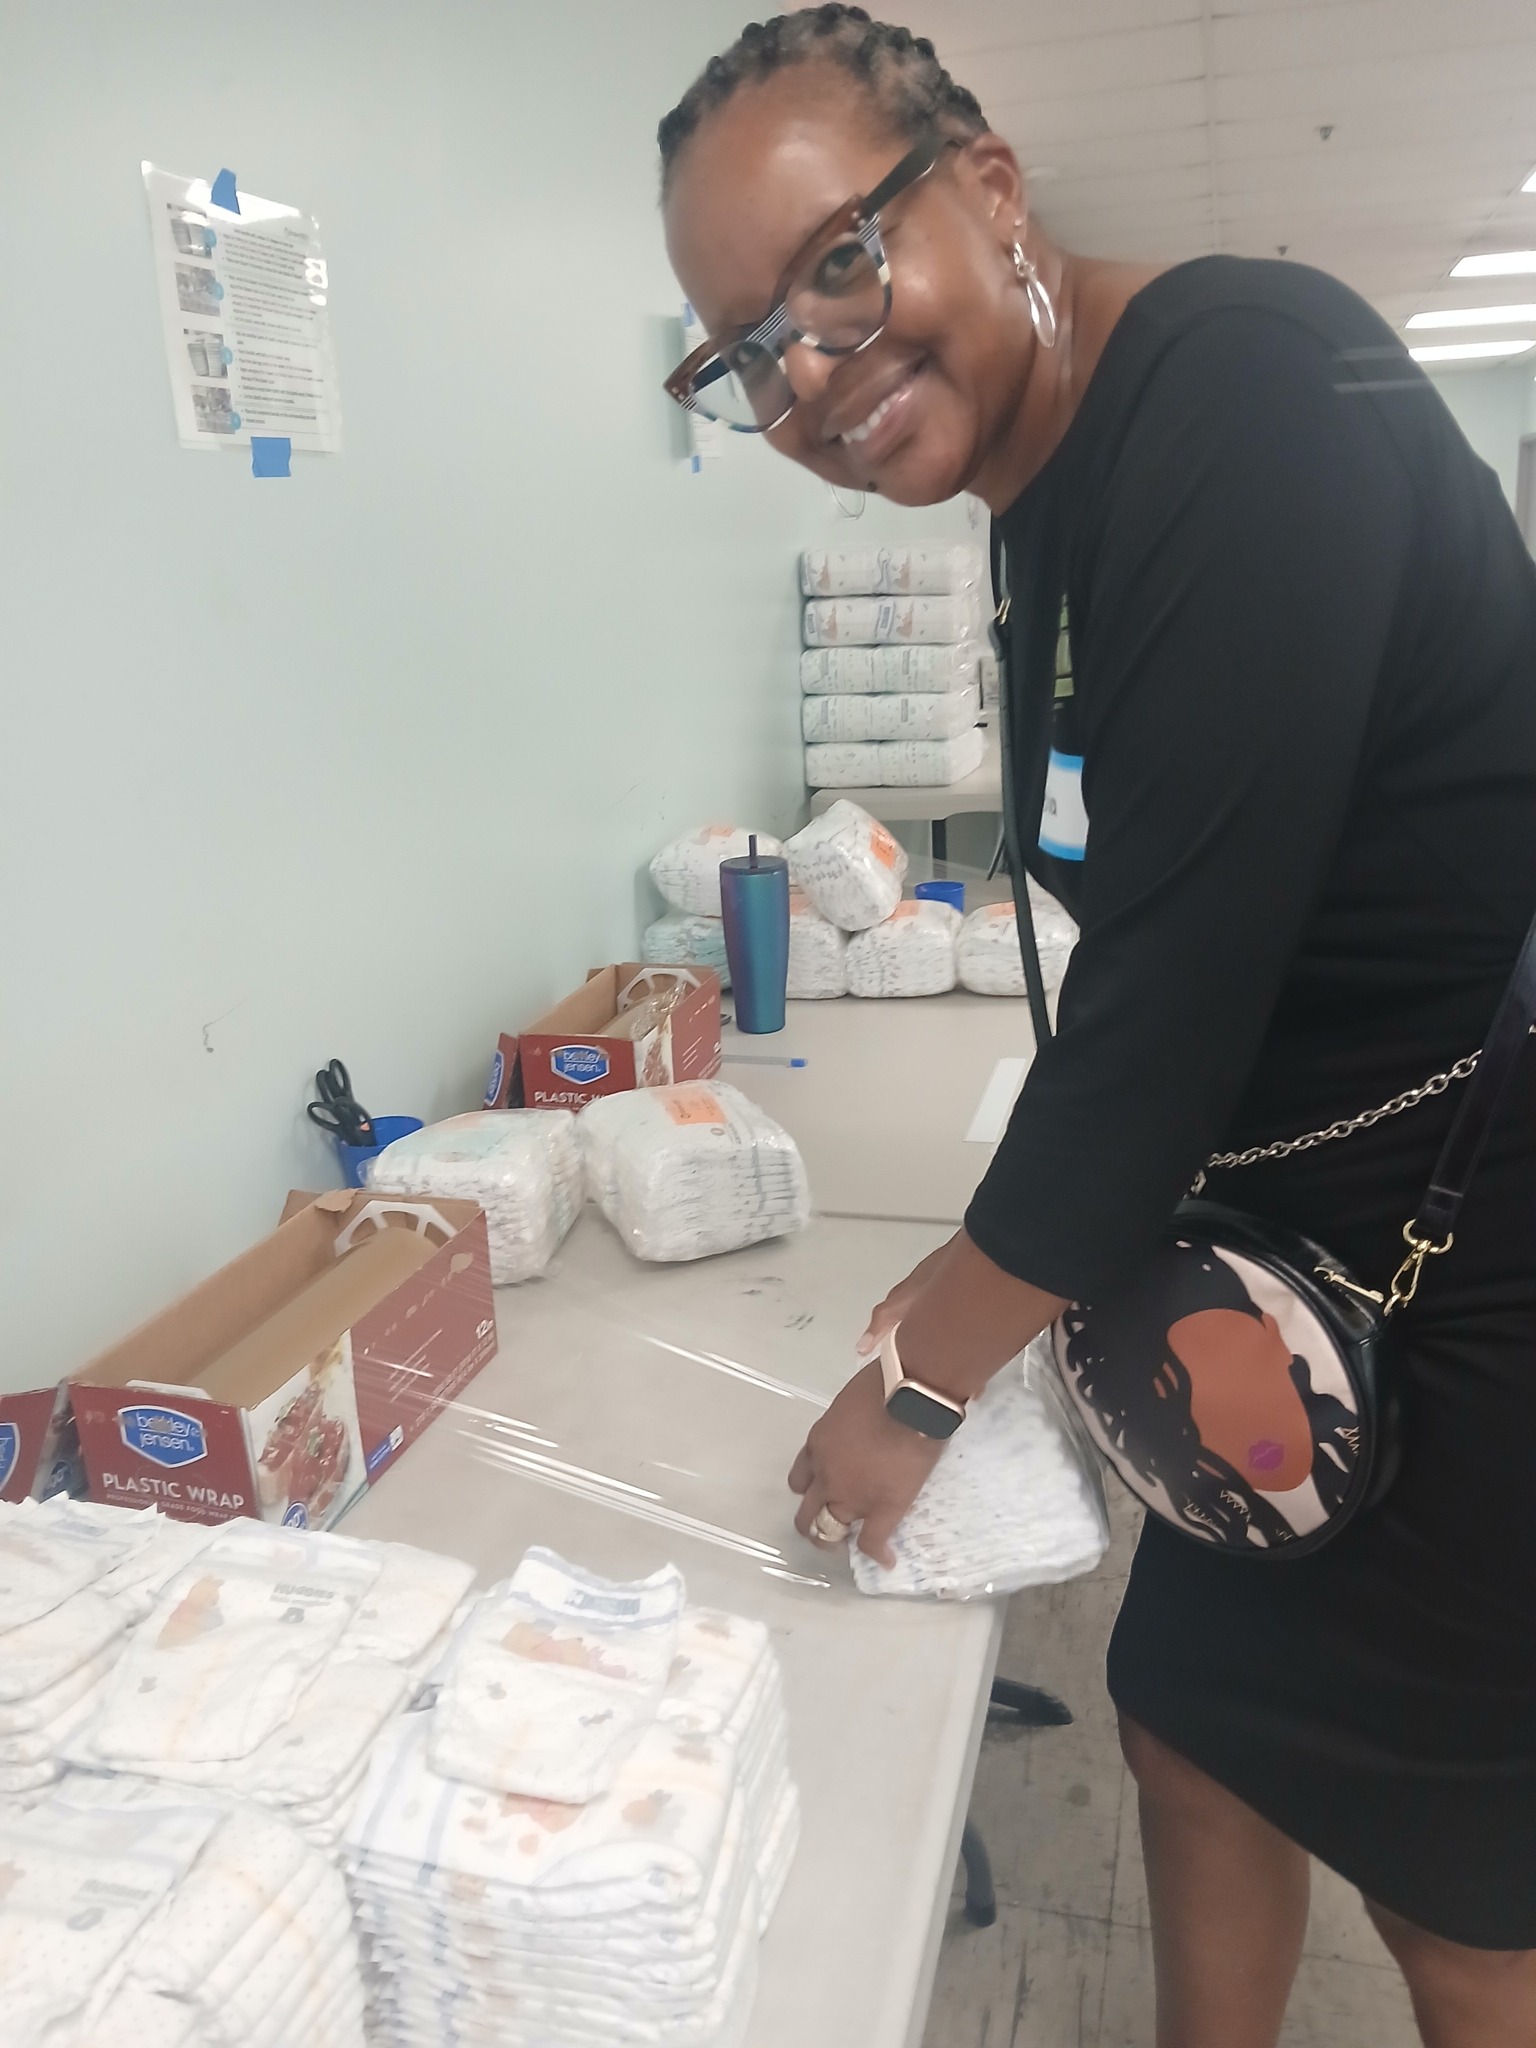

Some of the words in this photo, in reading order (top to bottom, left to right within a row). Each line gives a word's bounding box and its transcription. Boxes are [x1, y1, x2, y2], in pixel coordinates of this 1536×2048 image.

[534, 1091, 588, 1104] PLASTIC
[103, 1473, 182, 1498] PLASTIC
[186, 1484, 245, 1510] WRAP
